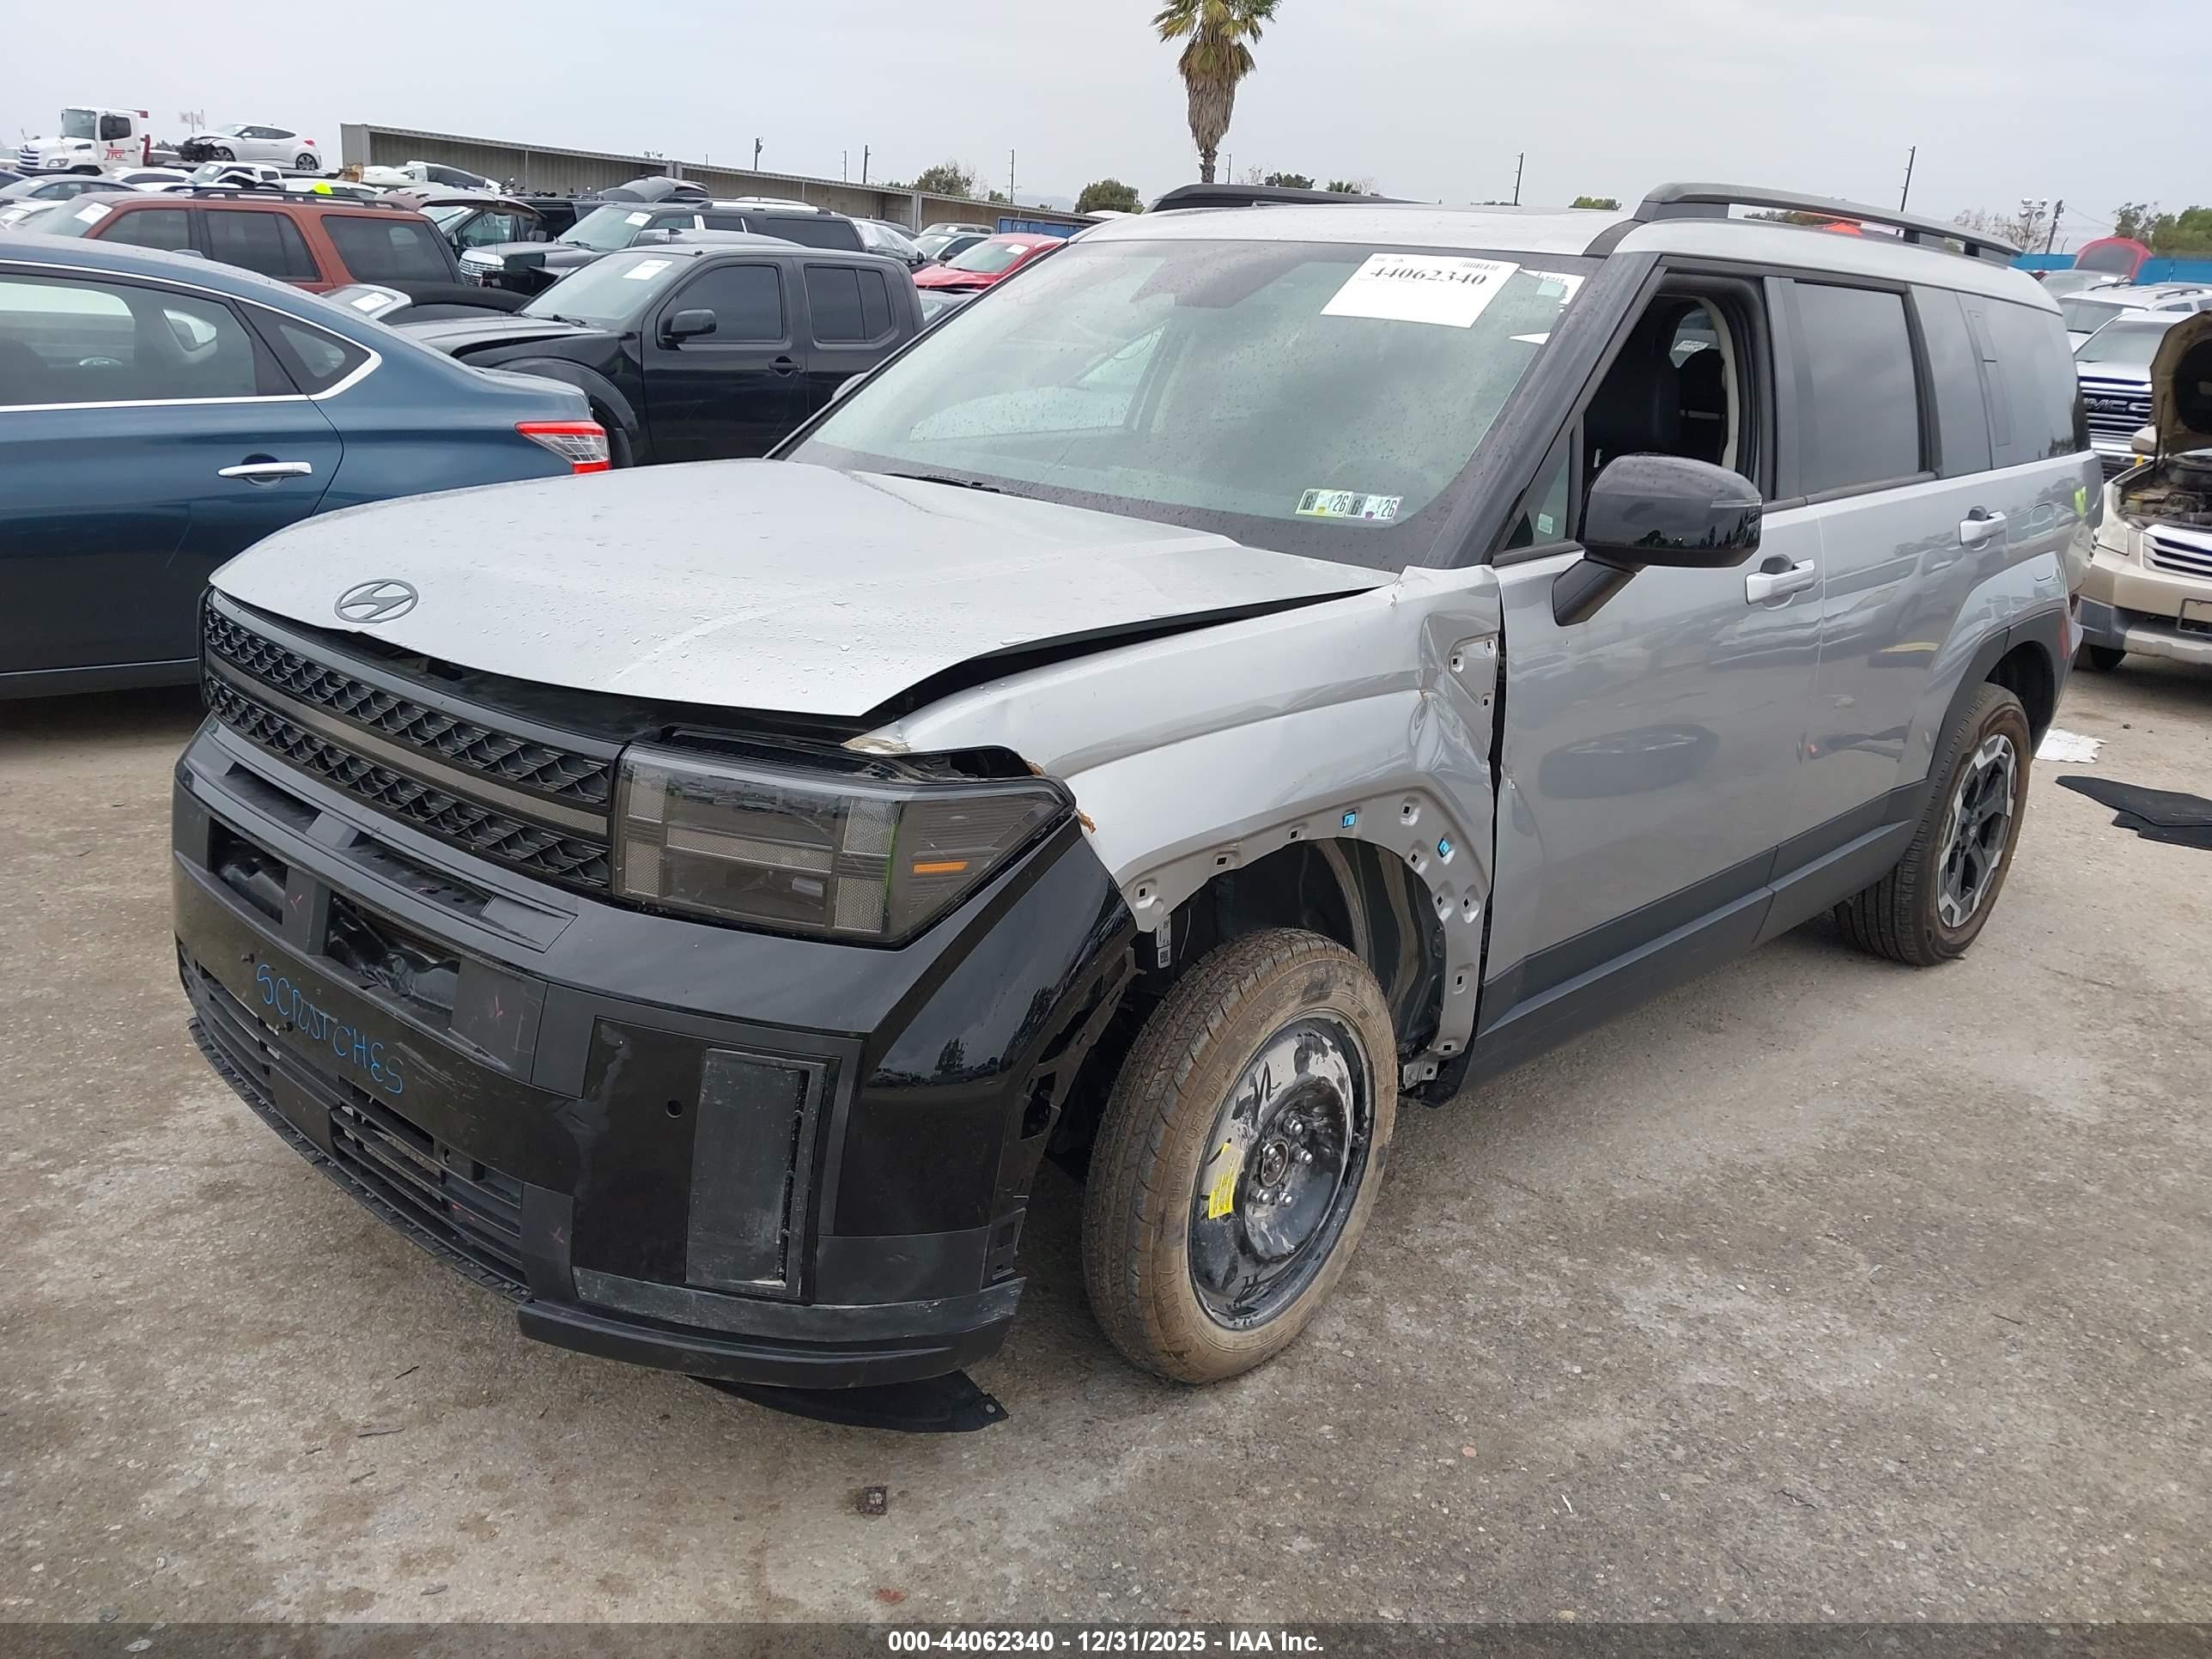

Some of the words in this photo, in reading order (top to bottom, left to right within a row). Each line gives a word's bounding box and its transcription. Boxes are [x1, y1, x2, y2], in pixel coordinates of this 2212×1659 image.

[1370, 266, 1488, 287] 44062340
[1332, 494, 1349, 513] 26
[1380, 499, 1397, 518] 26
